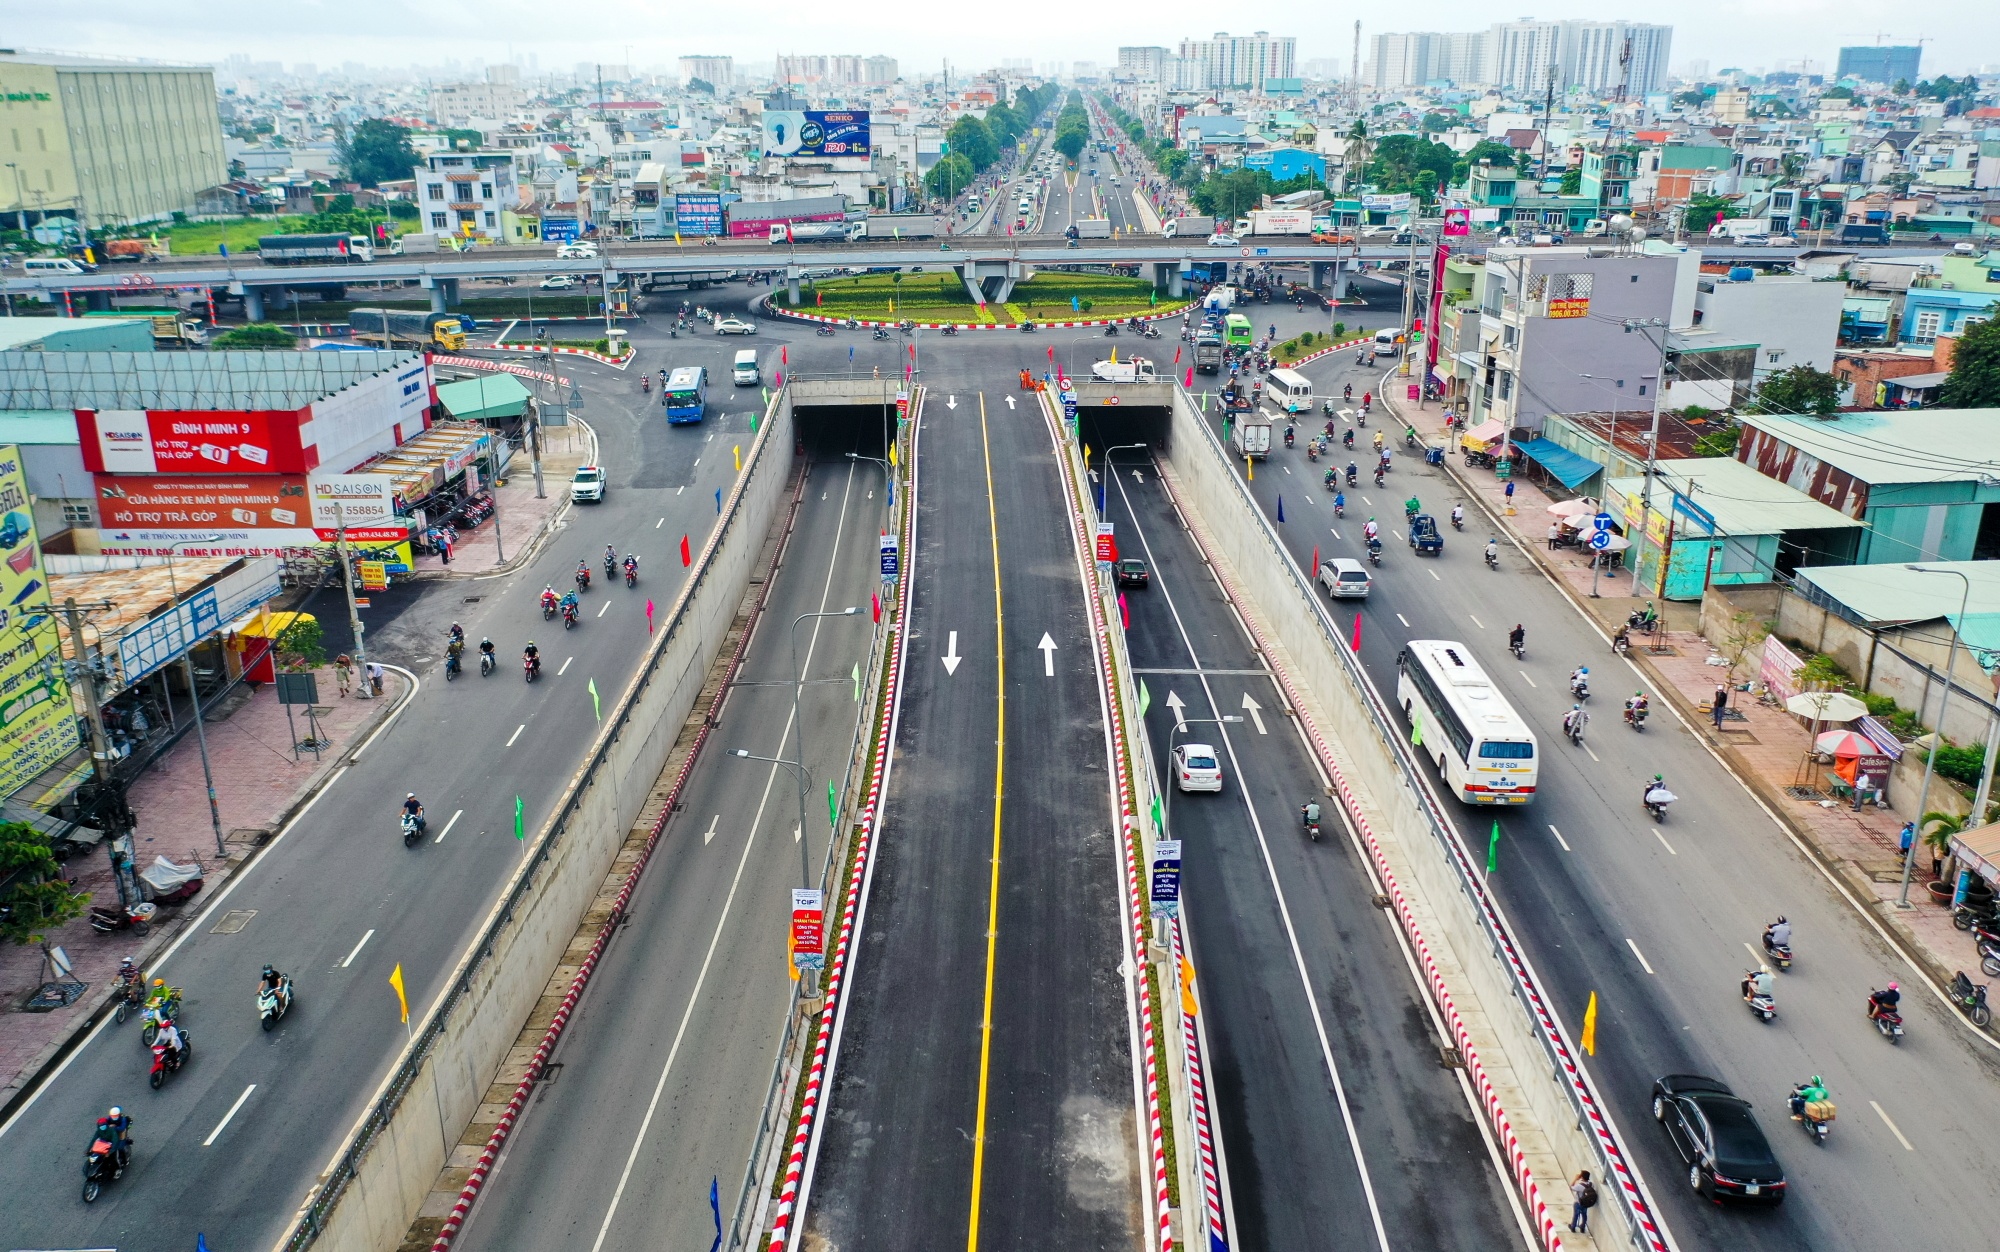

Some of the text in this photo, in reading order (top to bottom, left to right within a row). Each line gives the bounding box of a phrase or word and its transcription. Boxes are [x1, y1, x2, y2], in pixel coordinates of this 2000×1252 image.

[824, 142, 846, 153] F20
[172, 421, 250, 434] BÌNH MINH 9
[156, 438, 189, 449] HỖ TRỢ
[156, 448, 193, 460] TRẢ GÓP
[334, 484, 383, 494] SAISON
[128, 492, 280, 505] CỬA HÀNG XE MÁY BÌNH MINH 9
[115, 509, 218, 522] HỖ TRỢ TRẢ GÓP
[346, 506, 384, 515] 558854
[140, 532, 151, 540] HỆ
[152, 532, 178, 540] THỐNG
[122, 548, 134, 556] XE
[135, 546, 154, 556] TRẢ
[225, 545, 246, 556] BIỂN
[248, 545, 261, 556] SỐ
[12, 714, 74, 760] 0818.651.300
[14, 724, 76, 771] 0966.712.300
[1860, 757, 1875, 766] Cafe
